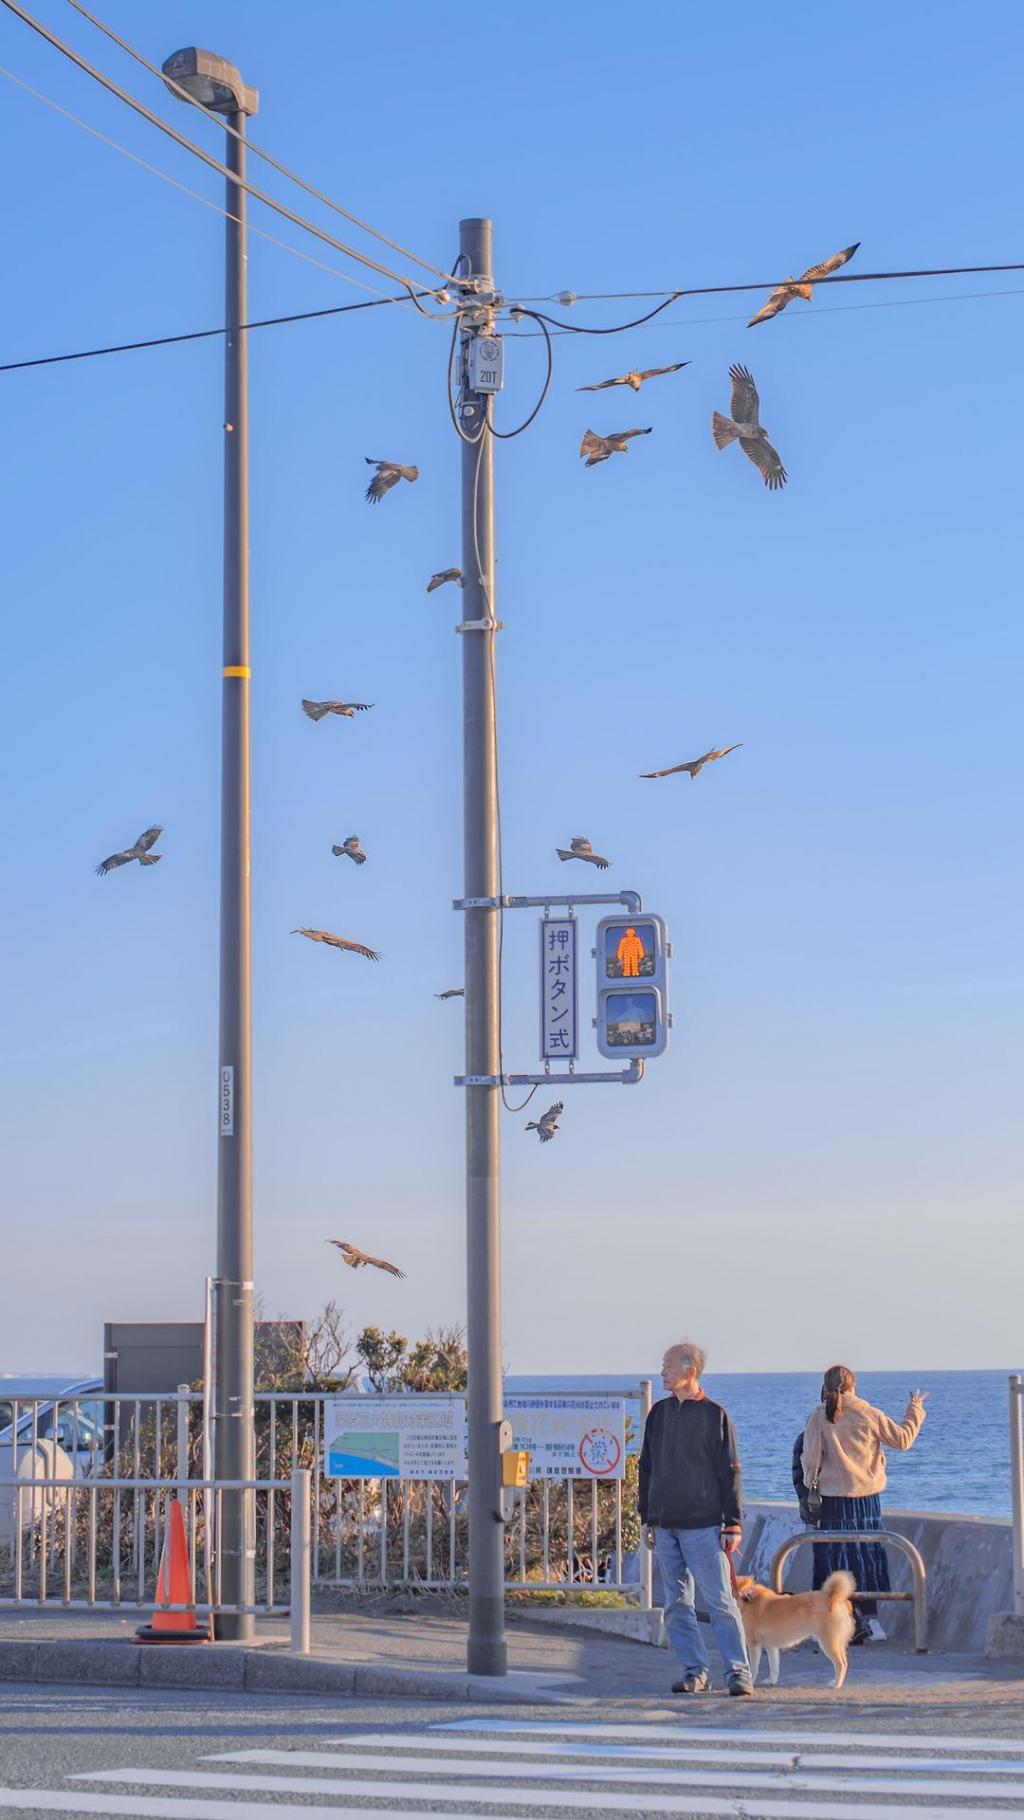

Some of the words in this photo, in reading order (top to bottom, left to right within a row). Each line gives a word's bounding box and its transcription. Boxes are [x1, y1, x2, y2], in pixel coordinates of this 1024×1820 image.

[480, 369, 497, 383] 20T
[548, 930, 570, 1049] 押ボタン式
[222, 1071, 231, 1125] 0538
